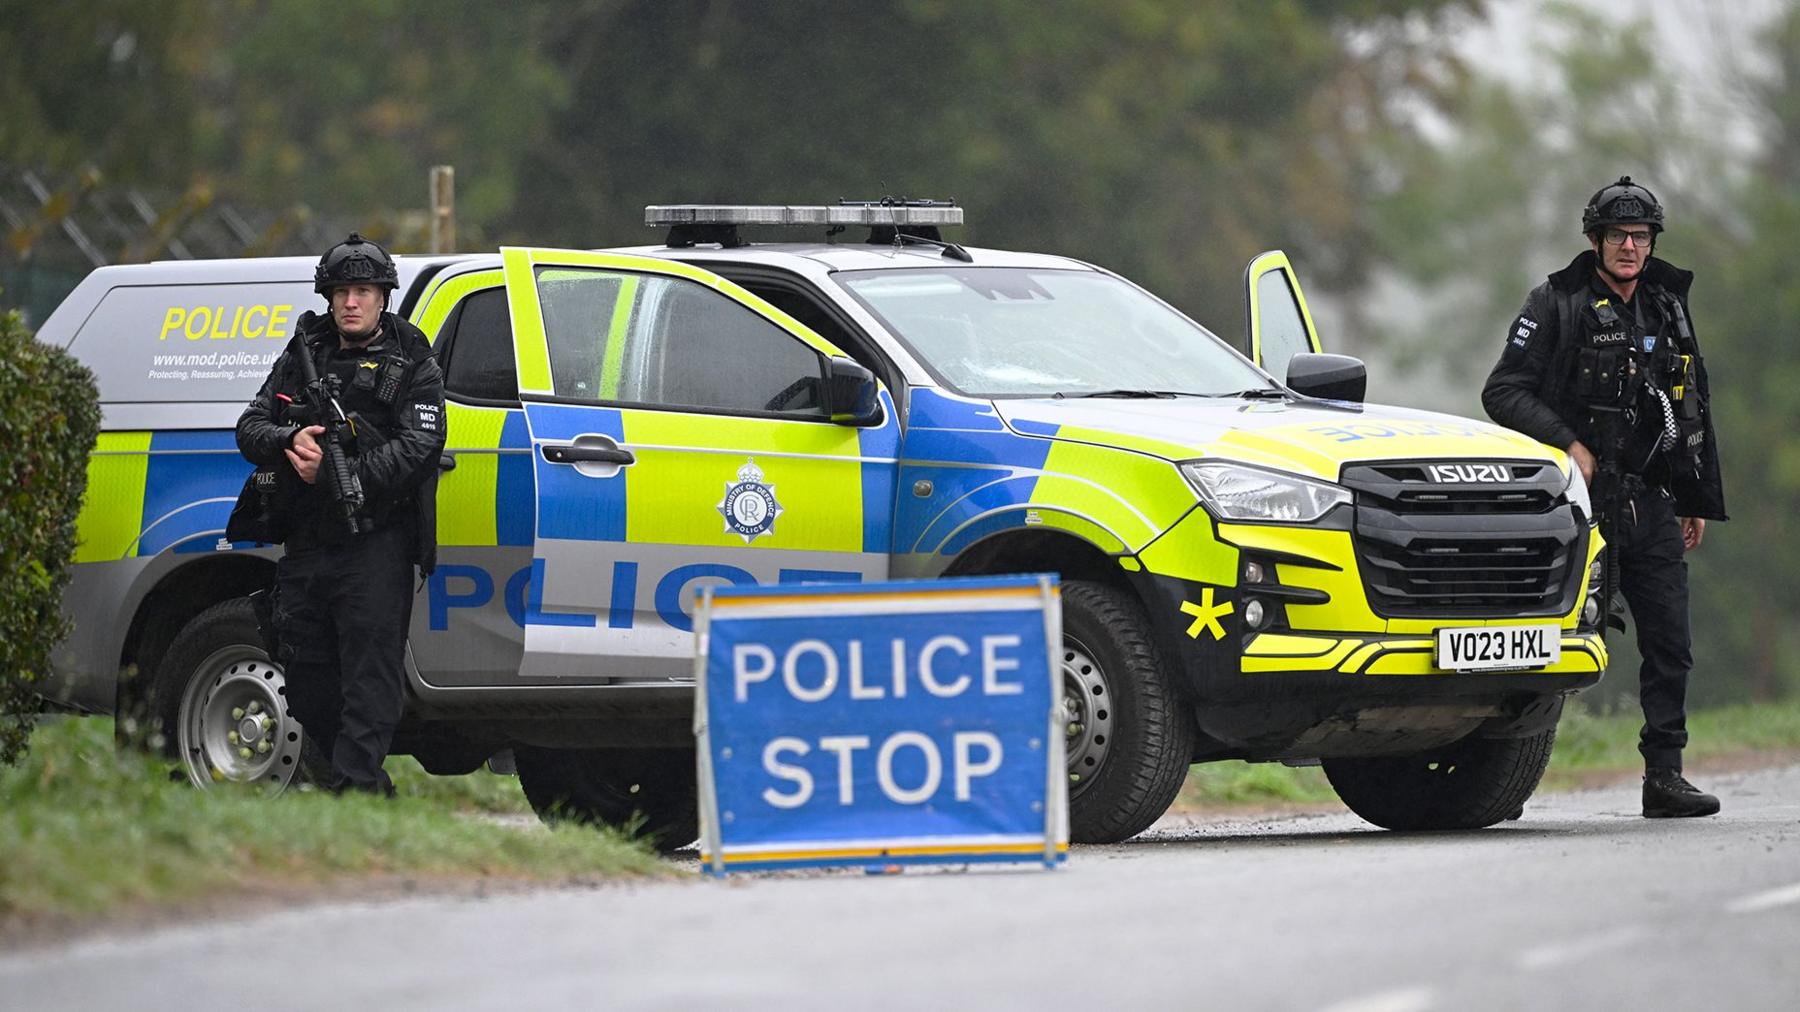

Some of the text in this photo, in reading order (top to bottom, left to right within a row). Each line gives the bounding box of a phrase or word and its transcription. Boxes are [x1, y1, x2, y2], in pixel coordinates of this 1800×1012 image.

[160, 304, 293, 341] POLICE
[1519, 316, 1538, 330] POLICE
[1517, 326, 1530, 338] MD
[1593, 332, 1627, 344] POLICE
[153, 352, 279, 369] www.mod.police.uk
[414, 404, 439, 412] POLICE
[420, 412, 436, 421] MD
[256, 471, 276, 485] POLICE
[1428, 464, 1511, 483] ISUZU
[726, 485, 744, 517] MINISTRY
[757, 486, 774, 518] DEFENCE
[734, 522, 764, 534] POLICE
[428, 558, 863, 633] PLIC
[1450, 629, 1551, 662] VO23 HXL
[733, 634, 1024, 702] POLICE
[762, 731, 1003, 809] STOP
